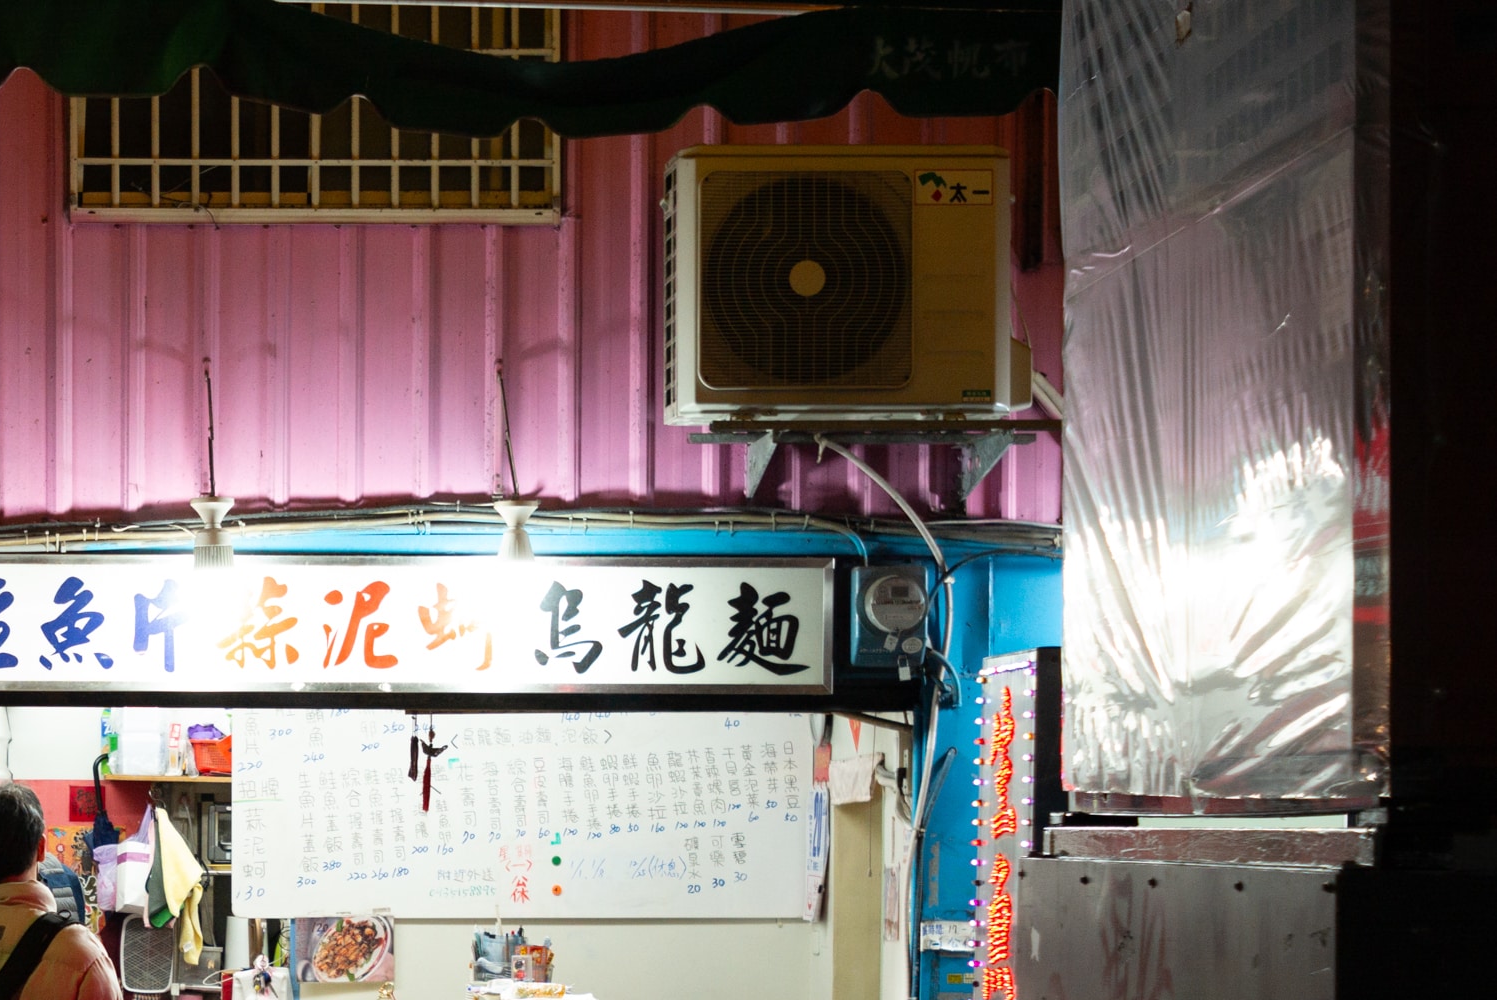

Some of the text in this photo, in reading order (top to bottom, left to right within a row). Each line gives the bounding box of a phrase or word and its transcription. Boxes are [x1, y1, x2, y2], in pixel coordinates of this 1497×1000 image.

[533, 578, 810, 675] 烏龍麵
[724, 717, 741, 730] 40
[764, 800, 778, 810] 50
[748, 811, 760, 823] 60
[783, 814, 799, 823] 50
[323, 860, 343, 872] 380
[296, 876, 317, 888] 300
[712, 878, 726, 889] 30
[734, 872, 749, 883] 30
[510, 875, 531, 905] 公休
[687, 884, 701, 895] 20
